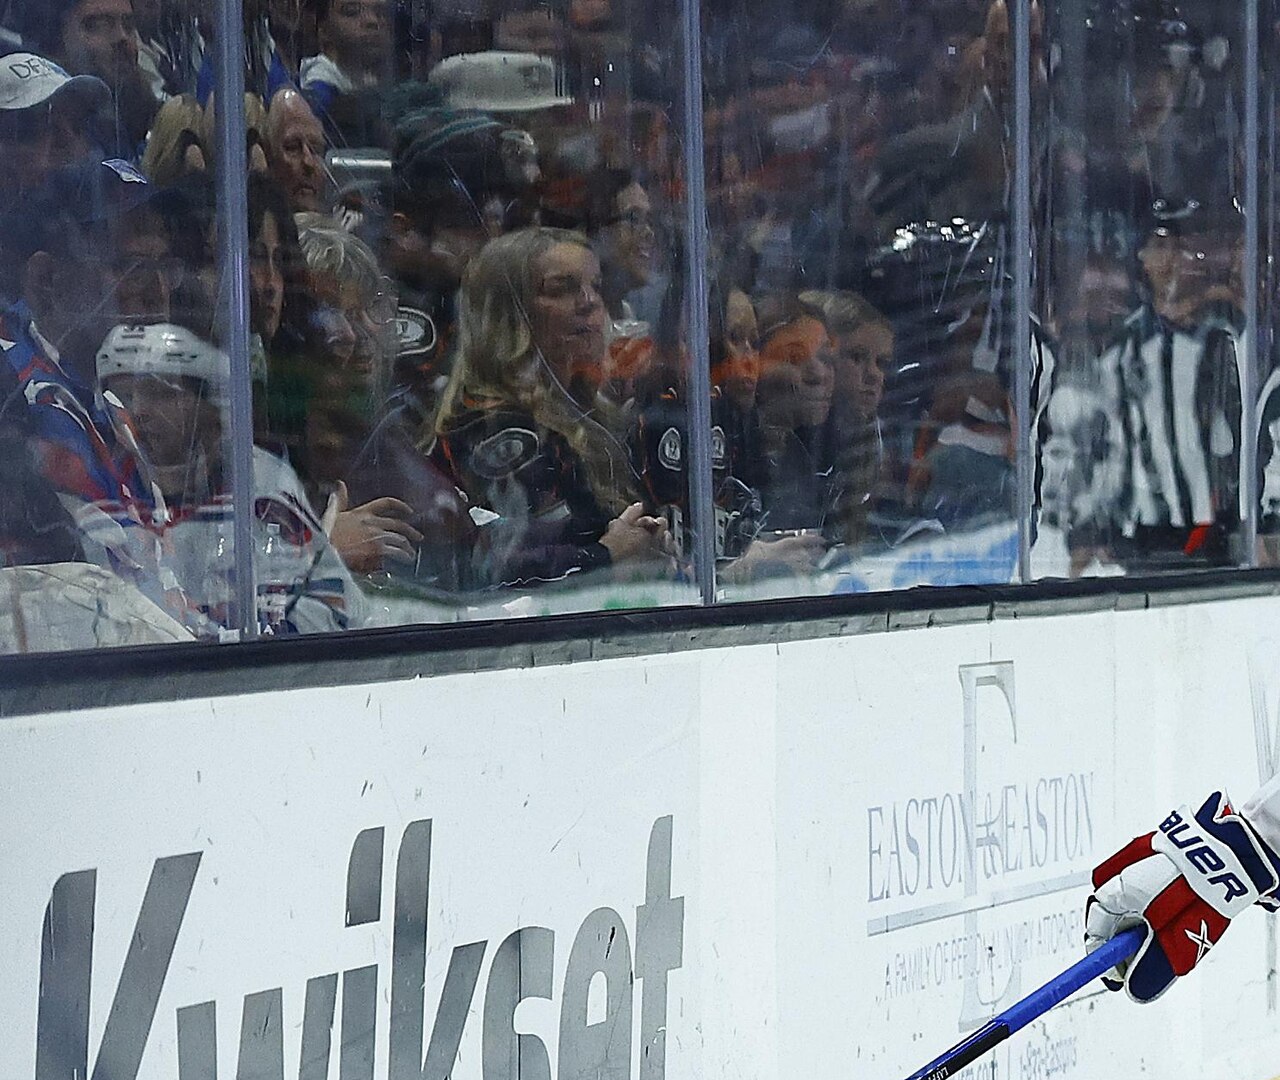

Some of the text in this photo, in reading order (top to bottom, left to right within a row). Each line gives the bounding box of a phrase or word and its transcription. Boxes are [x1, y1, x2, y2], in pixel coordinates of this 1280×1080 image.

[867, 790, 976, 903] EASTON
[1002, 771, 1094, 874] EASTON
[1158, 810, 1249, 903] AUER
